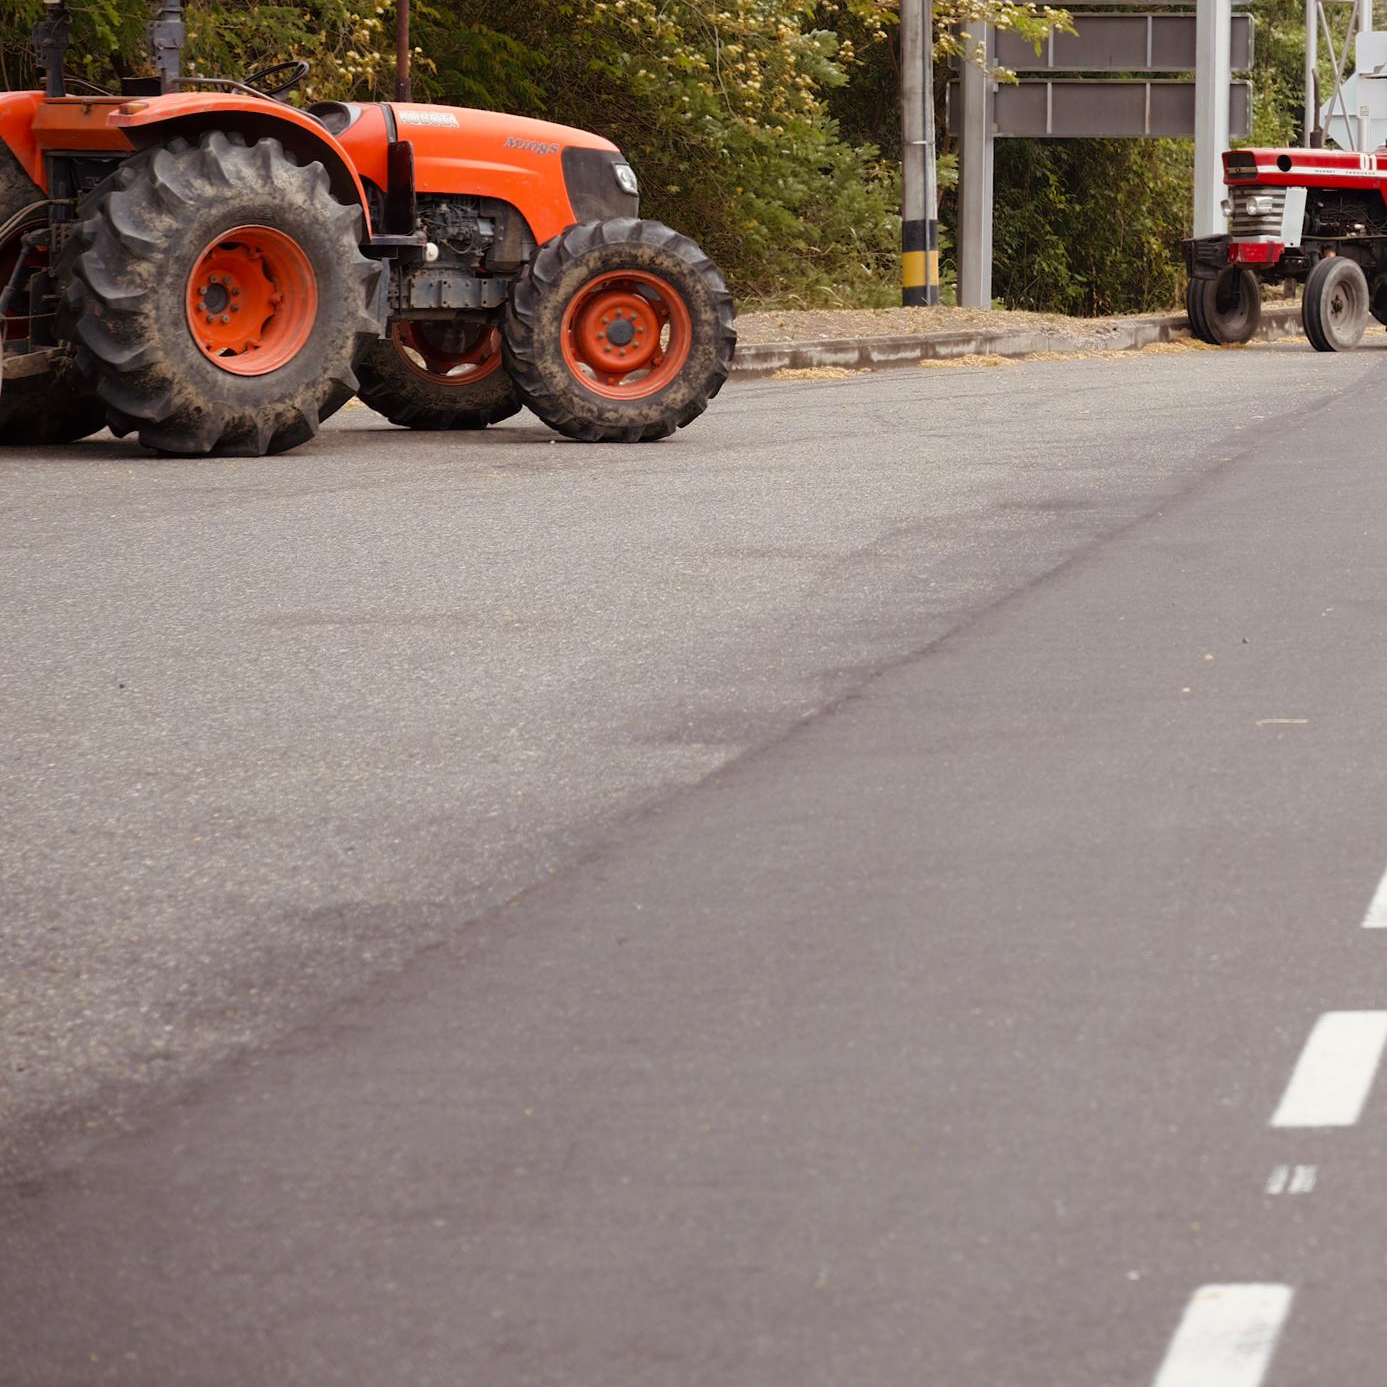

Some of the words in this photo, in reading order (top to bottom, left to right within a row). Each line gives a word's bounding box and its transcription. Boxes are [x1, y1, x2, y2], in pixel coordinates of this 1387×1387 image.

[399, 111, 461, 128] KUBOTA
[505, 136, 560, 157] M108S
[1360, 153, 1377, 172] 01
